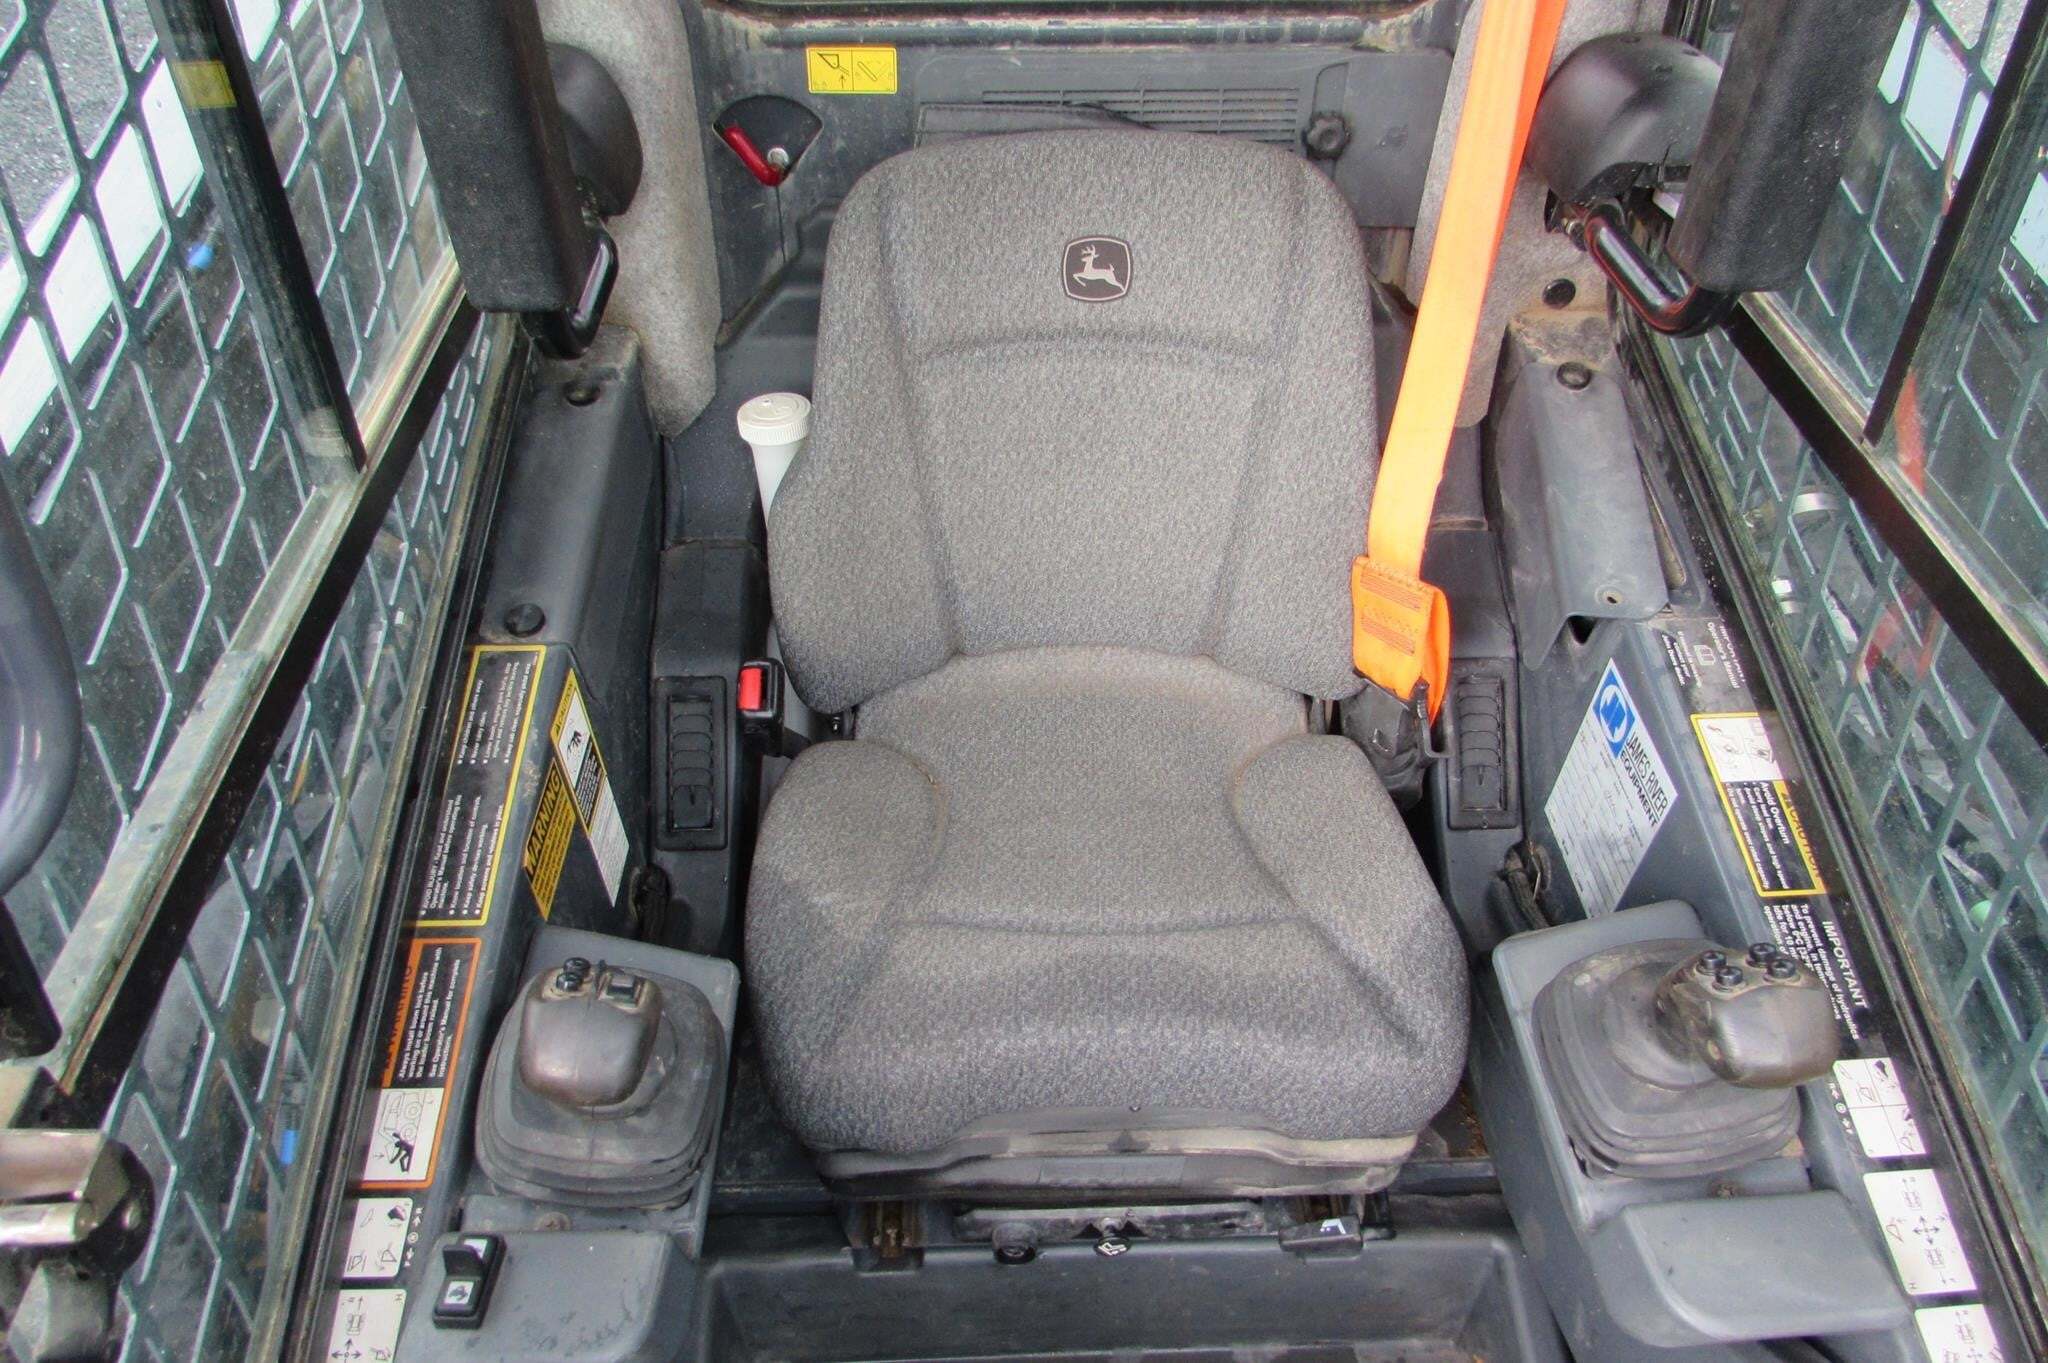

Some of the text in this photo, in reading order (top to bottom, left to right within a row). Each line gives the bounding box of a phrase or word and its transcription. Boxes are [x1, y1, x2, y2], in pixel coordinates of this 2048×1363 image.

[1723, 660, 1740, 688] Manual
[467, 711, 475, 720] and
[462, 722, 472, 743] children
[471, 742, 479, 758] Never
[475, 728, 484, 740] carry
[458, 744, 467, 758] Keep
[1625, 730, 1668, 816] JAMES RIVER
[1620, 748, 1658, 828] EQUIPMENT
[1743, 787, 1755, 803] Avoid
[1749, 804, 1762, 821] steep
[1751, 787, 1764, 802] Carry
[1759, 804, 1769, 816] load
[1759, 781, 1791, 843] Avoid Overturn
[440, 799, 454, 831] understand
[527, 768, 561, 876] WARNING
[437, 832, 446, 843] and
[462, 827, 474, 851] function
[487, 828, 500, 853] windows
[1765, 842, 1775, 854] and
[428, 794, 462, 908] Operator's Manual before operating this
[433, 844, 443, 859] Read
[459, 853, 468, 864] and
[471, 849, 482, 871] devices
[485, 854, 494, 865] and
[1769, 855, 1781, 868] high
[425, 865, 438, 887] INJURY
[454, 865, 465, 889] location
[466, 873, 477, 890] safety
[479, 867, 491, 890] screens
[1775, 870, 1789, 888] speed
[421, 889, 432, 908] AVOID
[449, 891, 459, 908] Know
[462, 892, 472, 907] Keep
[476, 892, 486, 907] Keep
[1781, 904, 1796, 928] below
[1790, 904, 1801, 918] and
[1762, 905, 1783, 944] operation
[1778, 921, 1788, 932] for
[1784, 936, 1795, 944] 10
[1795, 921, 1814, 950] engine,
[433, 947, 442, 960] with
[1809, 953, 1819, 961] in
[1821, 921, 1867, 1007] IMPORTANT
[427, 962, 439, 989] machine
[448, 959, 461, 988] complete
[1799, 903, 1860, 1039] To prevent damage of hydraulics
[424, 991, 432, 1003] this
[418, 1005, 429, 1028] around
[440, 1000, 451, 1025] Manual
[398, 971, 429, 1079] Always install boom lock before
[424, 1021, 434, 1041] boom
[414, 1038, 421, 1048] on
[419, 1042, 429, 1064] loader
[431, 1027, 446, 1062] Operator's
[407, 1050, 420, 1078] working
[416, 1065, 424, 1078] the
[428, 1064, 437, 1077] See
